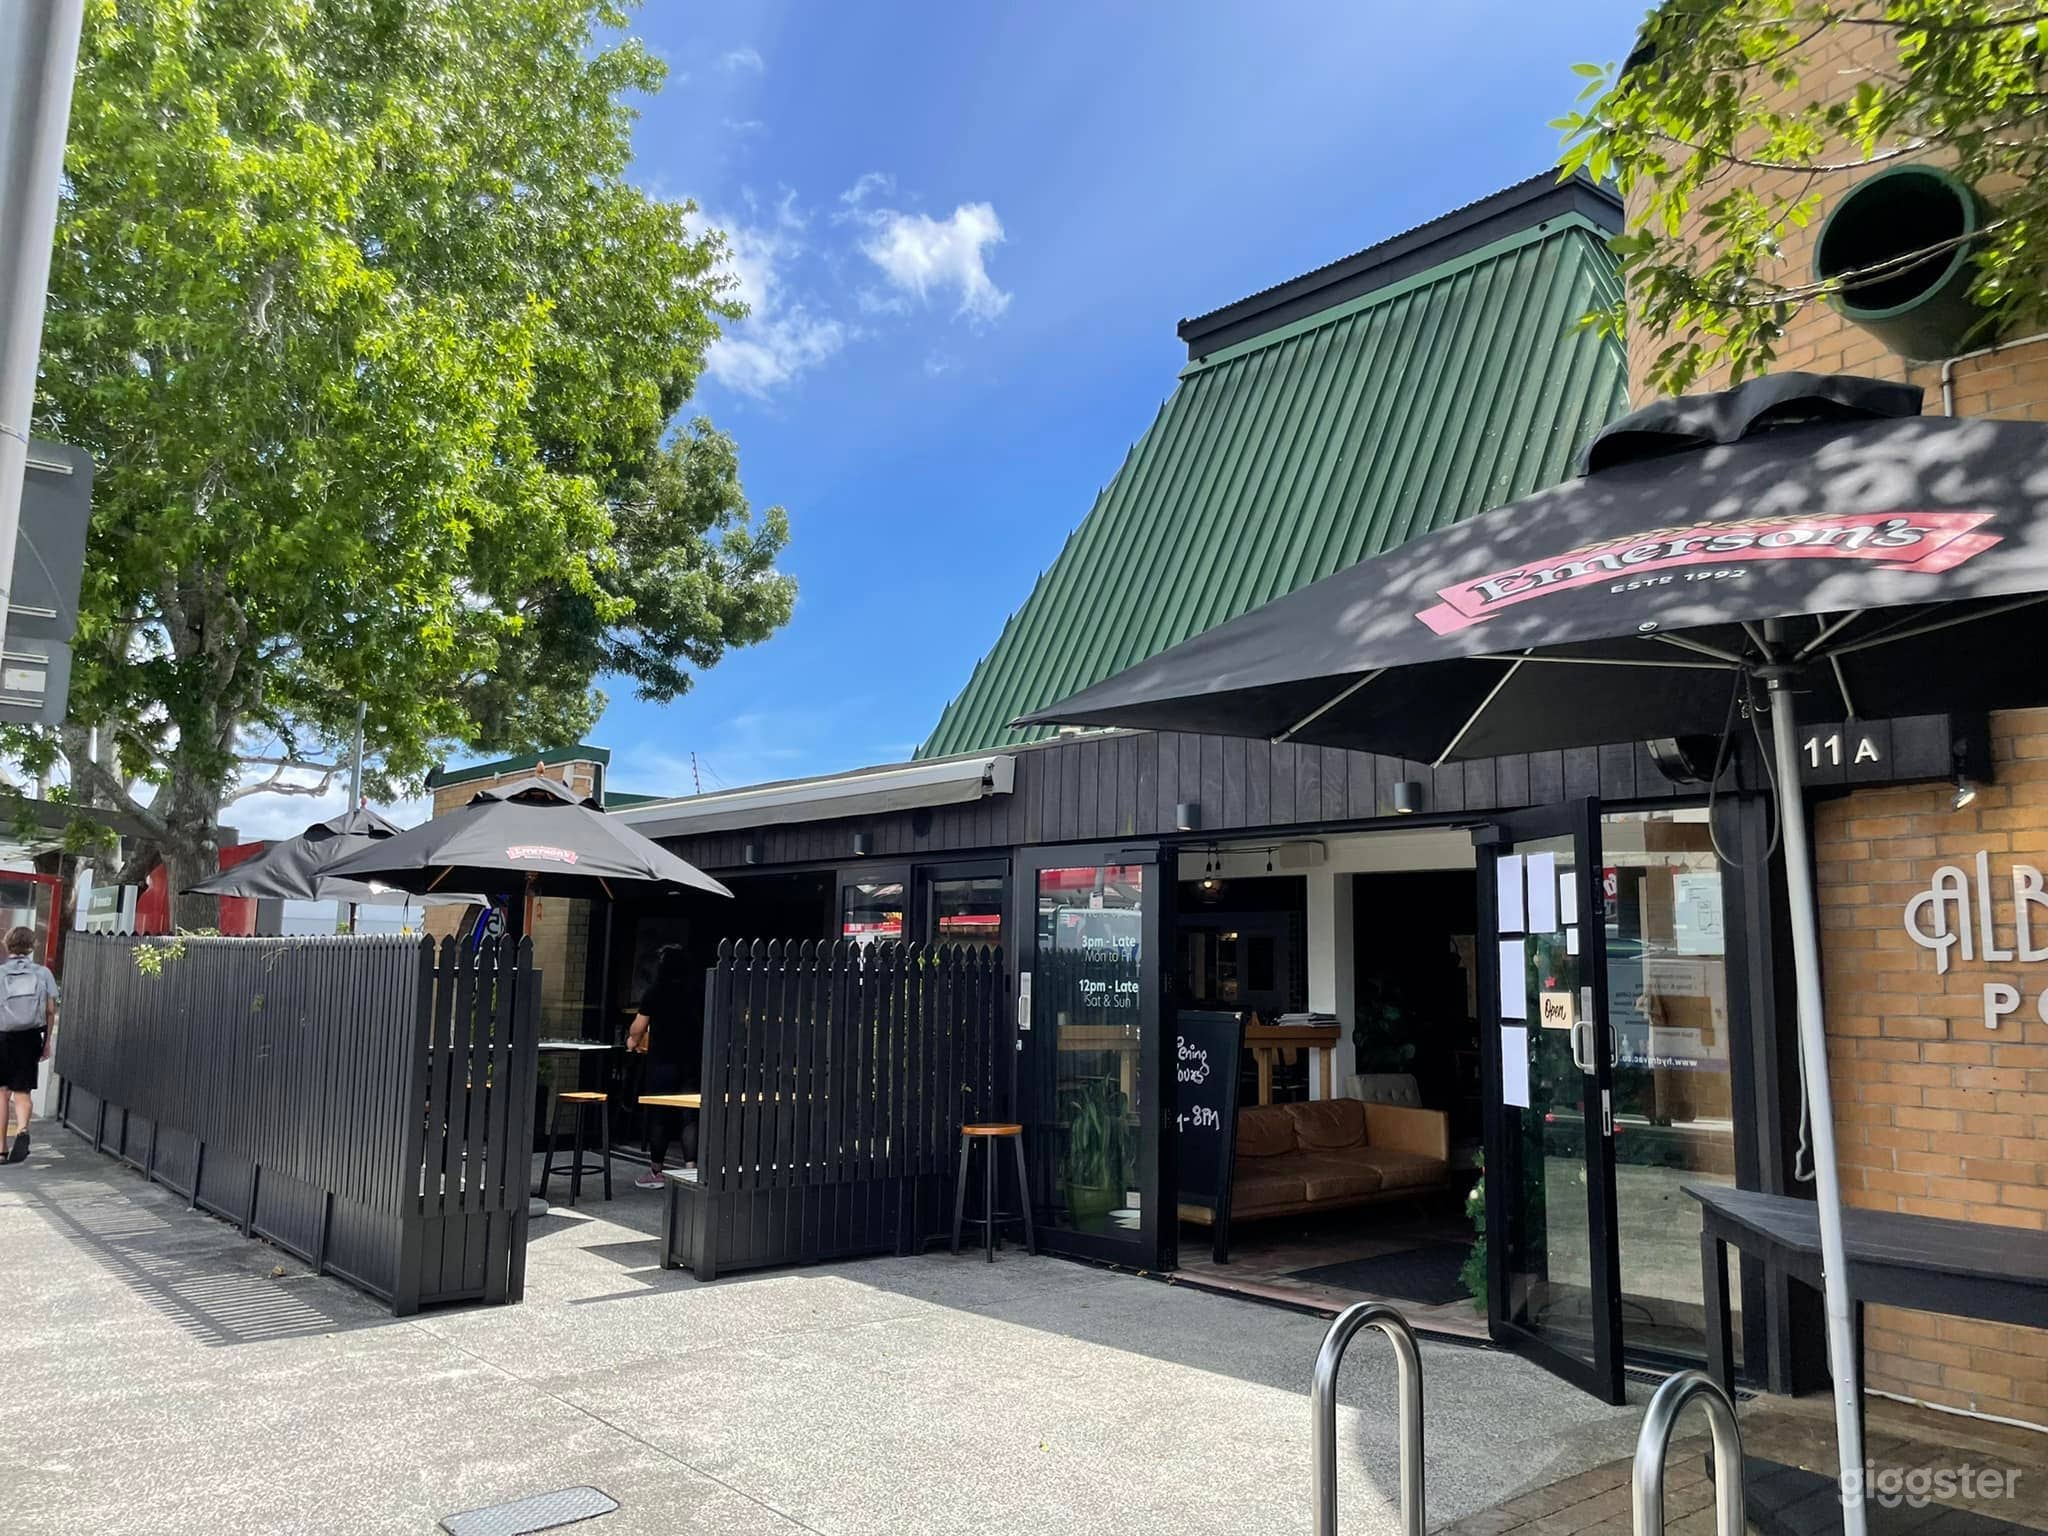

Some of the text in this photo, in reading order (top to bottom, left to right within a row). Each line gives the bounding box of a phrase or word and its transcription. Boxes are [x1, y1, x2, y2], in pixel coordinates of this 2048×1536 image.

[1468, 517, 1932, 606] Emerson's
[1684, 569, 1747, 582] 1992
[1804, 734, 1880, 768] 11 A
[1081, 936, 1104, 950] 3pm
[1112, 936, 1136, 947] Late
[1085, 950, 1133, 962] Mon to Fri
[1079, 979, 1106, 994] 12pm
[1115, 979, 1139, 993] Late
[1086, 994, 1131, 1008] Sat & Sun
[1545, 998, 1567, 1023] Open
[1177, 1063, 1204, 1085] ours
